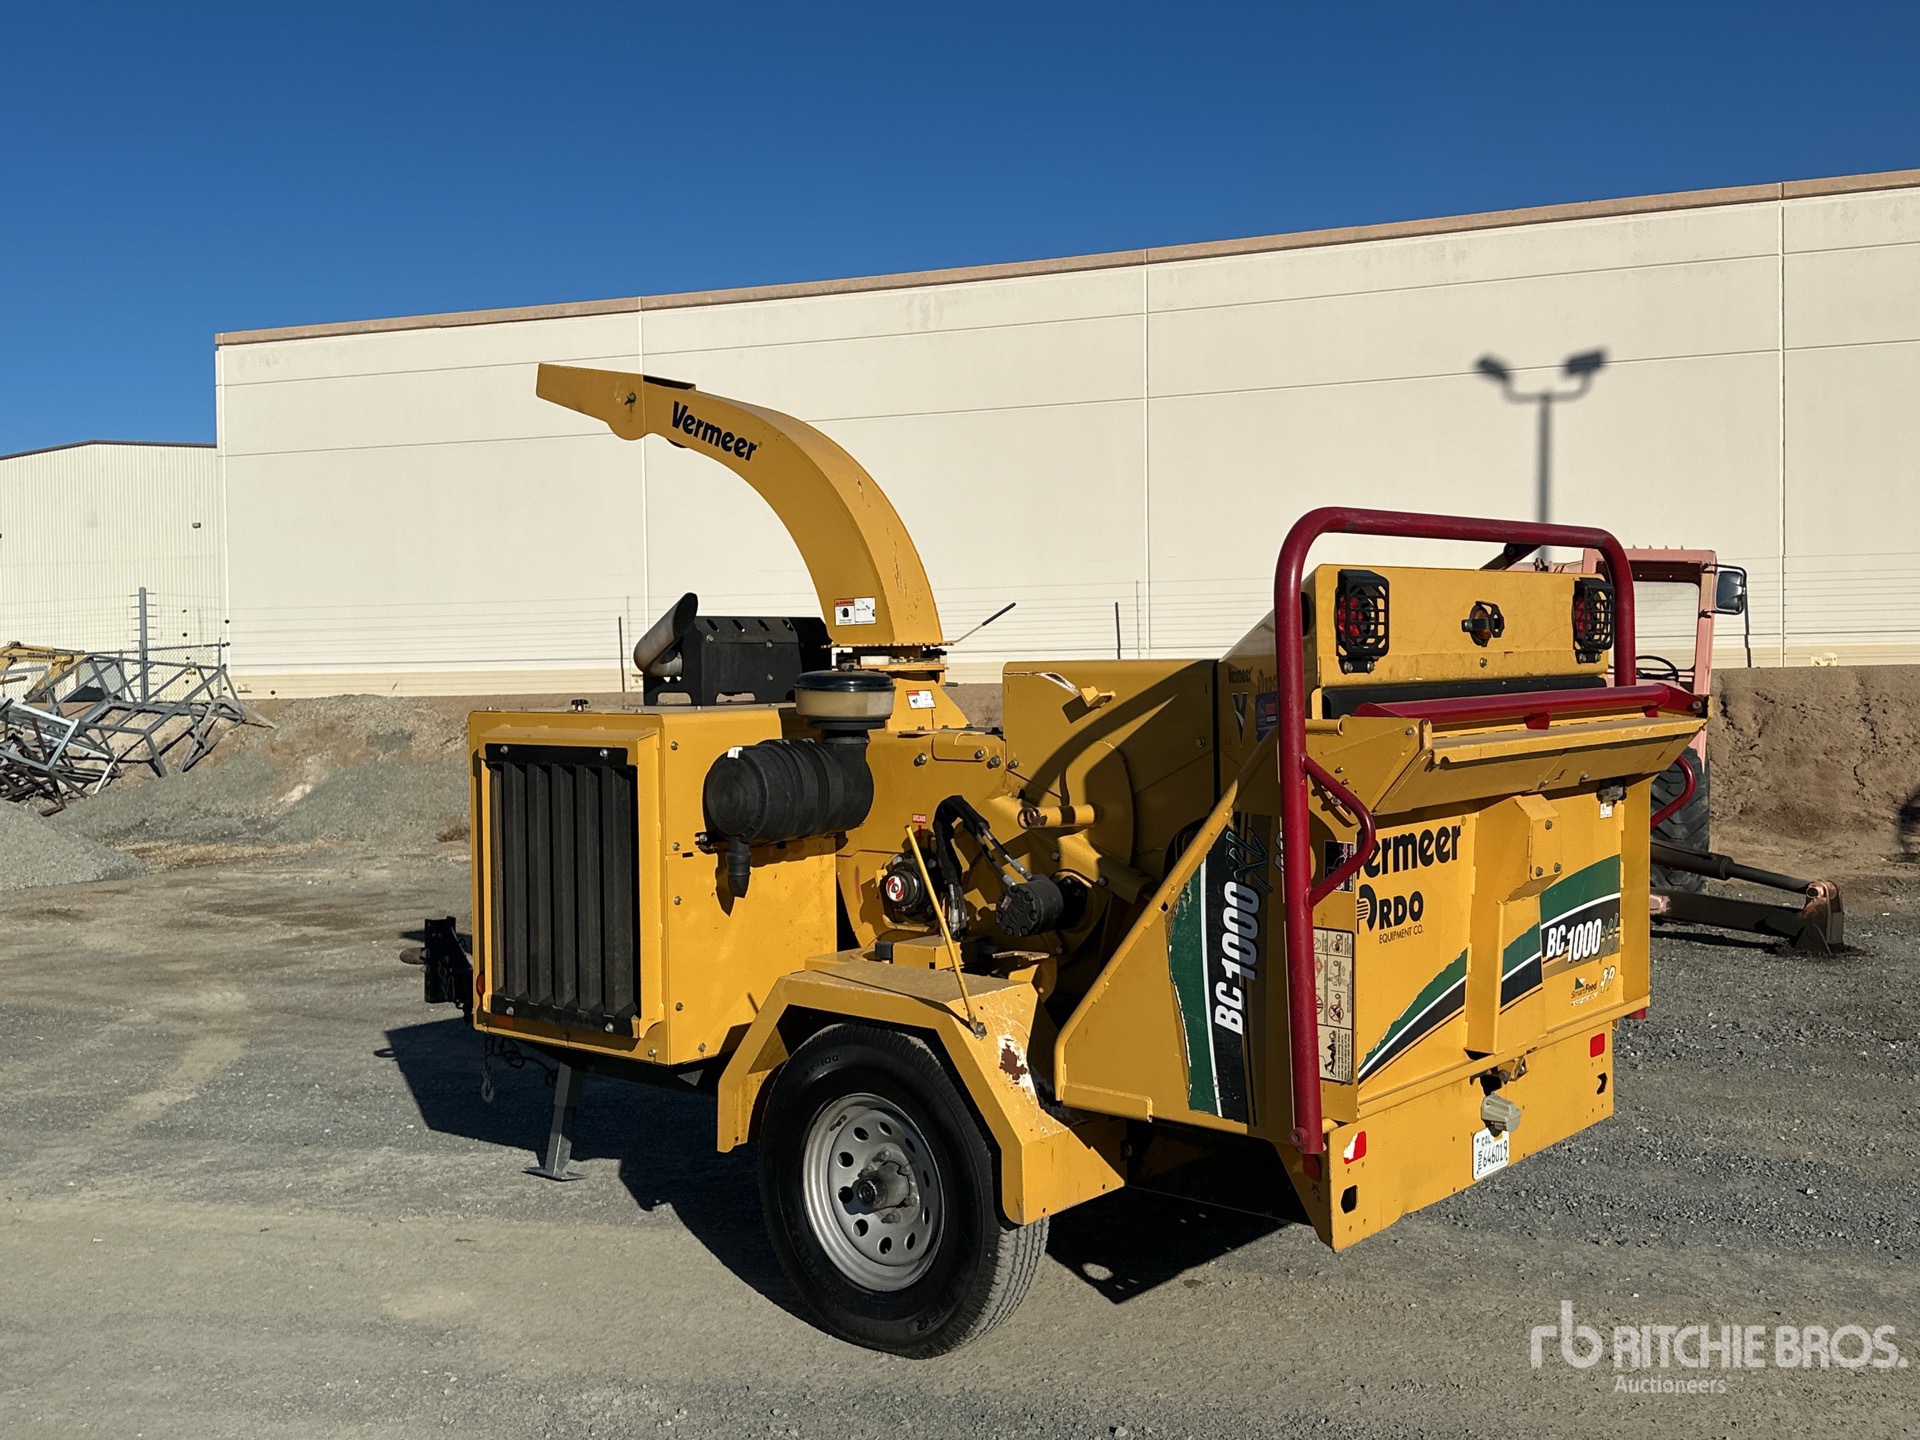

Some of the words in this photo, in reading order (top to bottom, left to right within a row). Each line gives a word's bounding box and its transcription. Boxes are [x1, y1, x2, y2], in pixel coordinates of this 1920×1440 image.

[672, 400, 758, 461] Vermeer
[1379, 927, 1412, 944] EQUIPMENT
[1483, 1140, 1508, 1167] 646019
